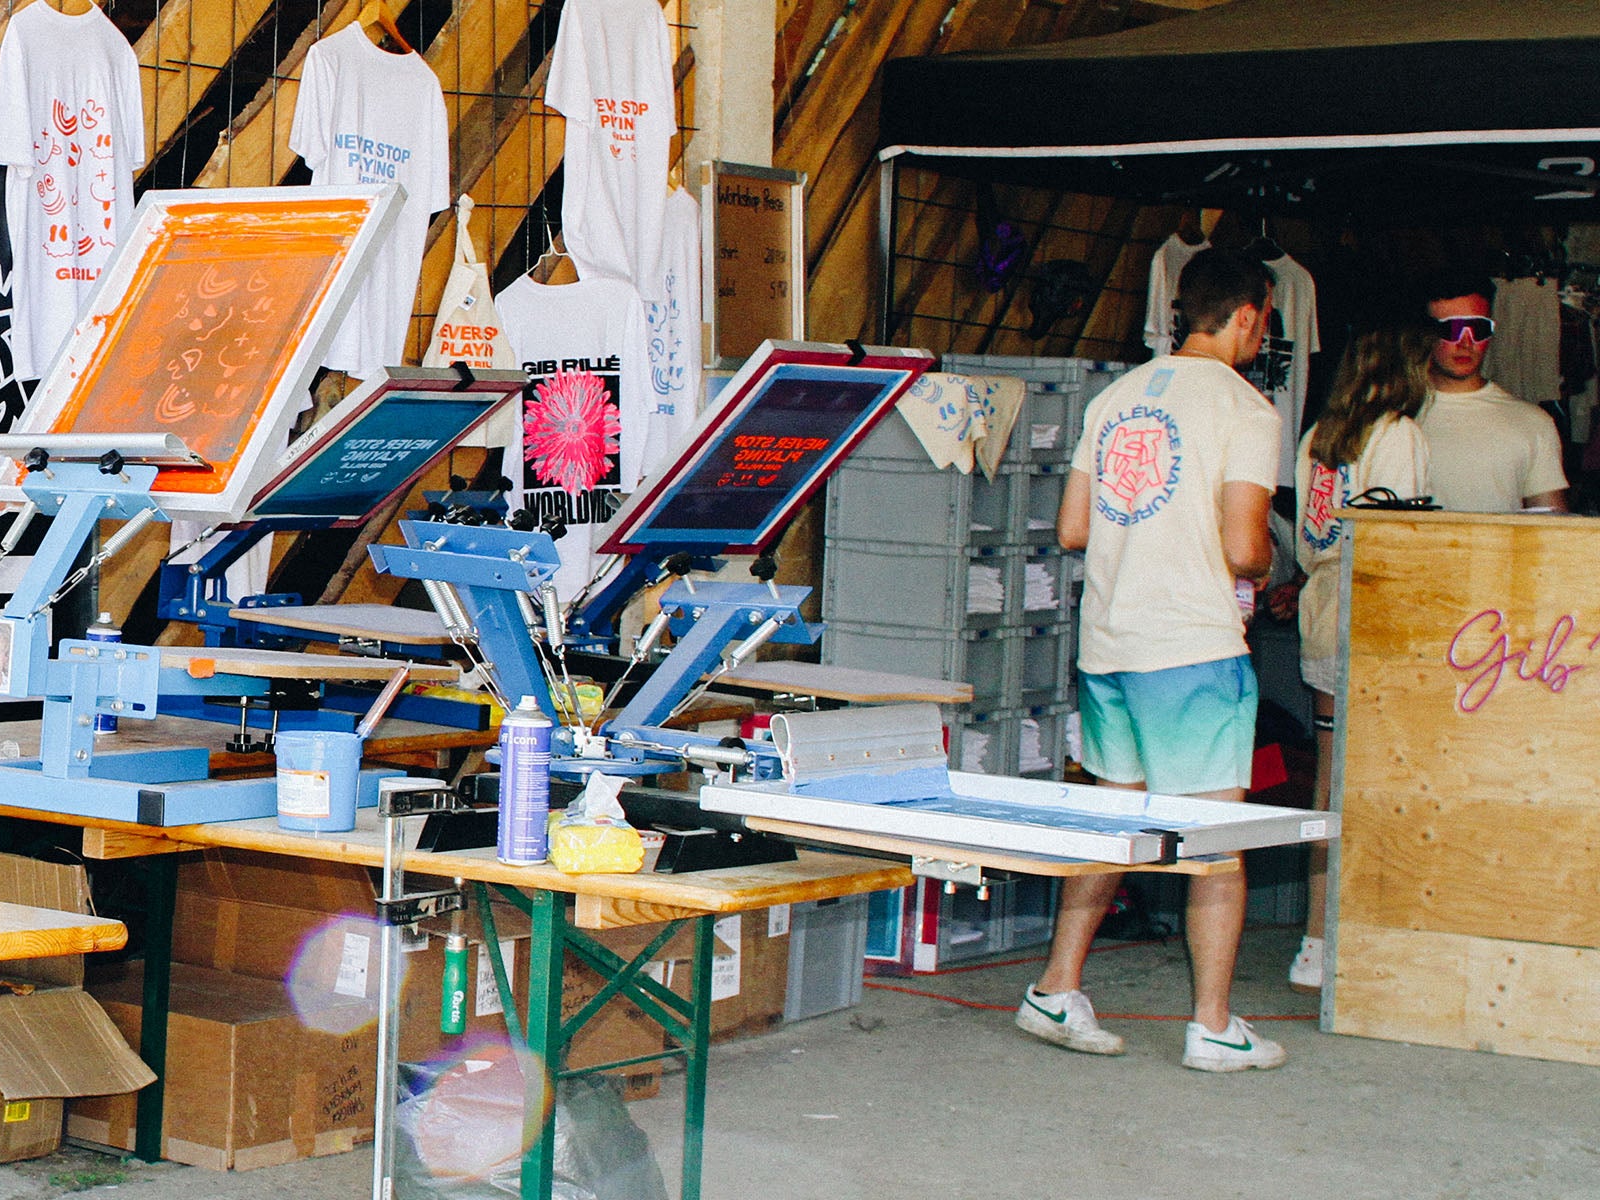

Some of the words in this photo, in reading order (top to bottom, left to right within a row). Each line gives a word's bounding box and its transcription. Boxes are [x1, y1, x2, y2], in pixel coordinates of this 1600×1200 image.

[376, 142, 411, 163] STOP
[437, 323, 482, 341] EVER
[522, 359, 557, 375] GIB
[562, 354, 620, 372] RILLÉ
[1449, 608, 1584, 713] Gib
